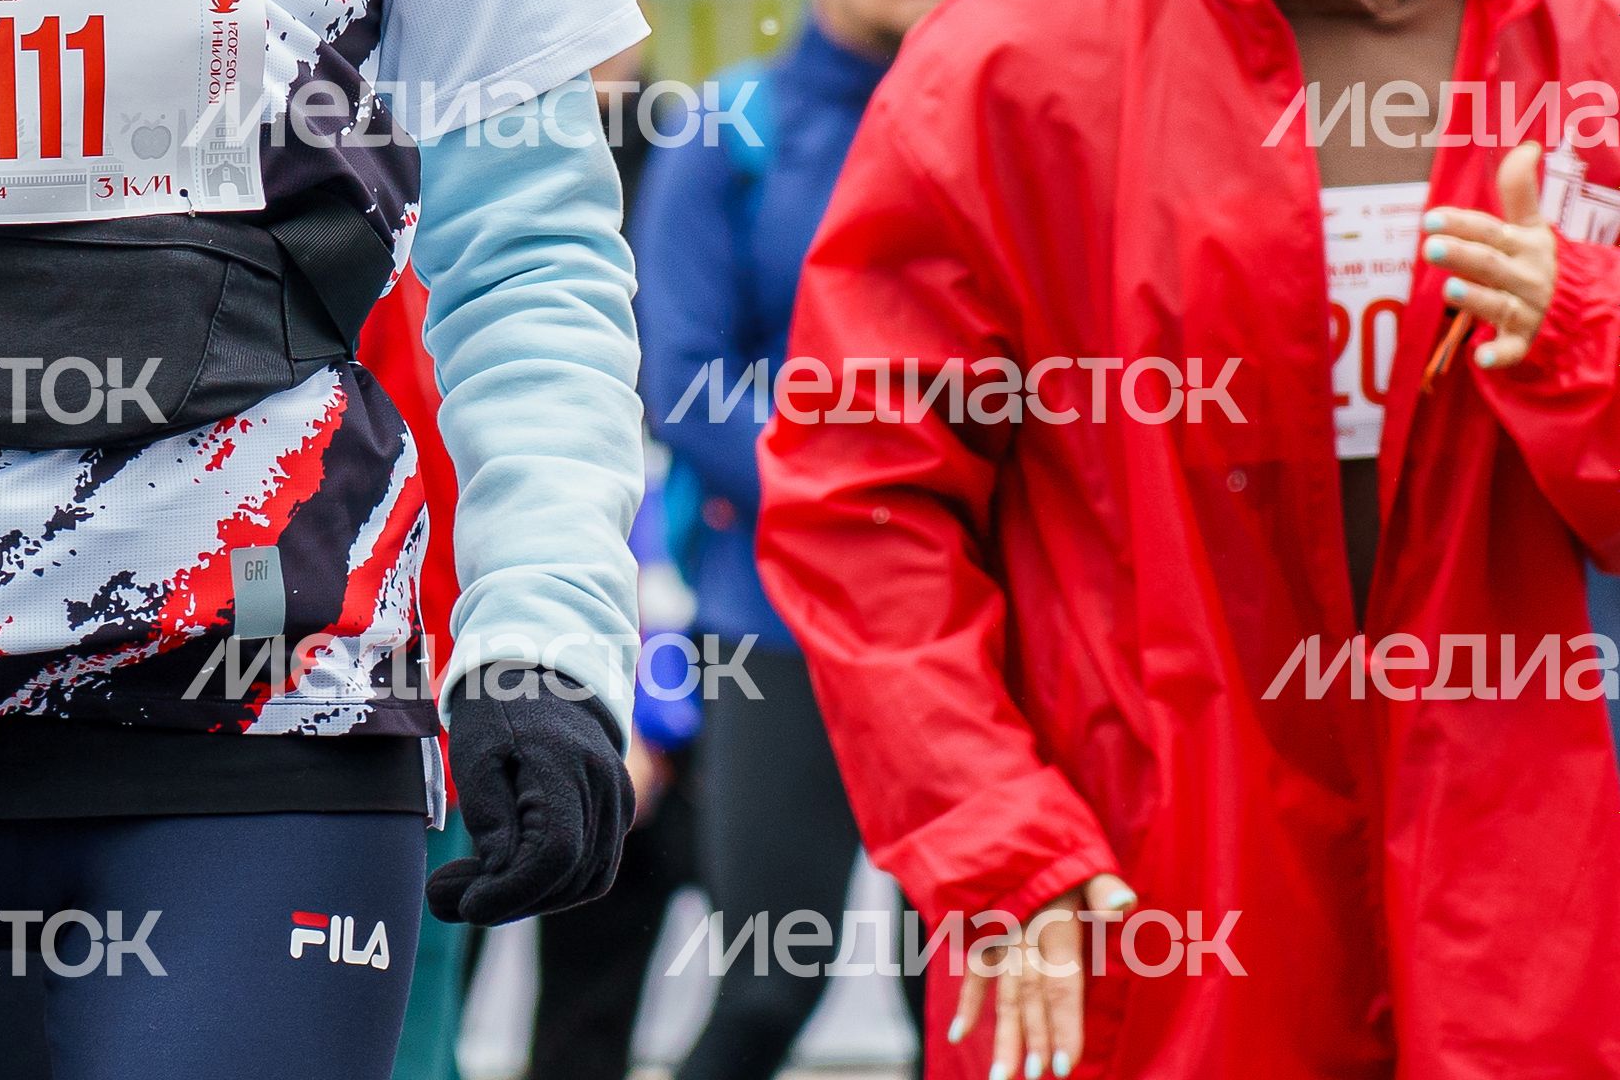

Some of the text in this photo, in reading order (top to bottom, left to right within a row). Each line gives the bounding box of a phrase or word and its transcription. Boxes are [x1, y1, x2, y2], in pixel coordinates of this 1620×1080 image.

[95, 174, 172, 199] 3 КМ
[244, 559, 269, 582] GRi
[289, 910, 391, 971] FILA
